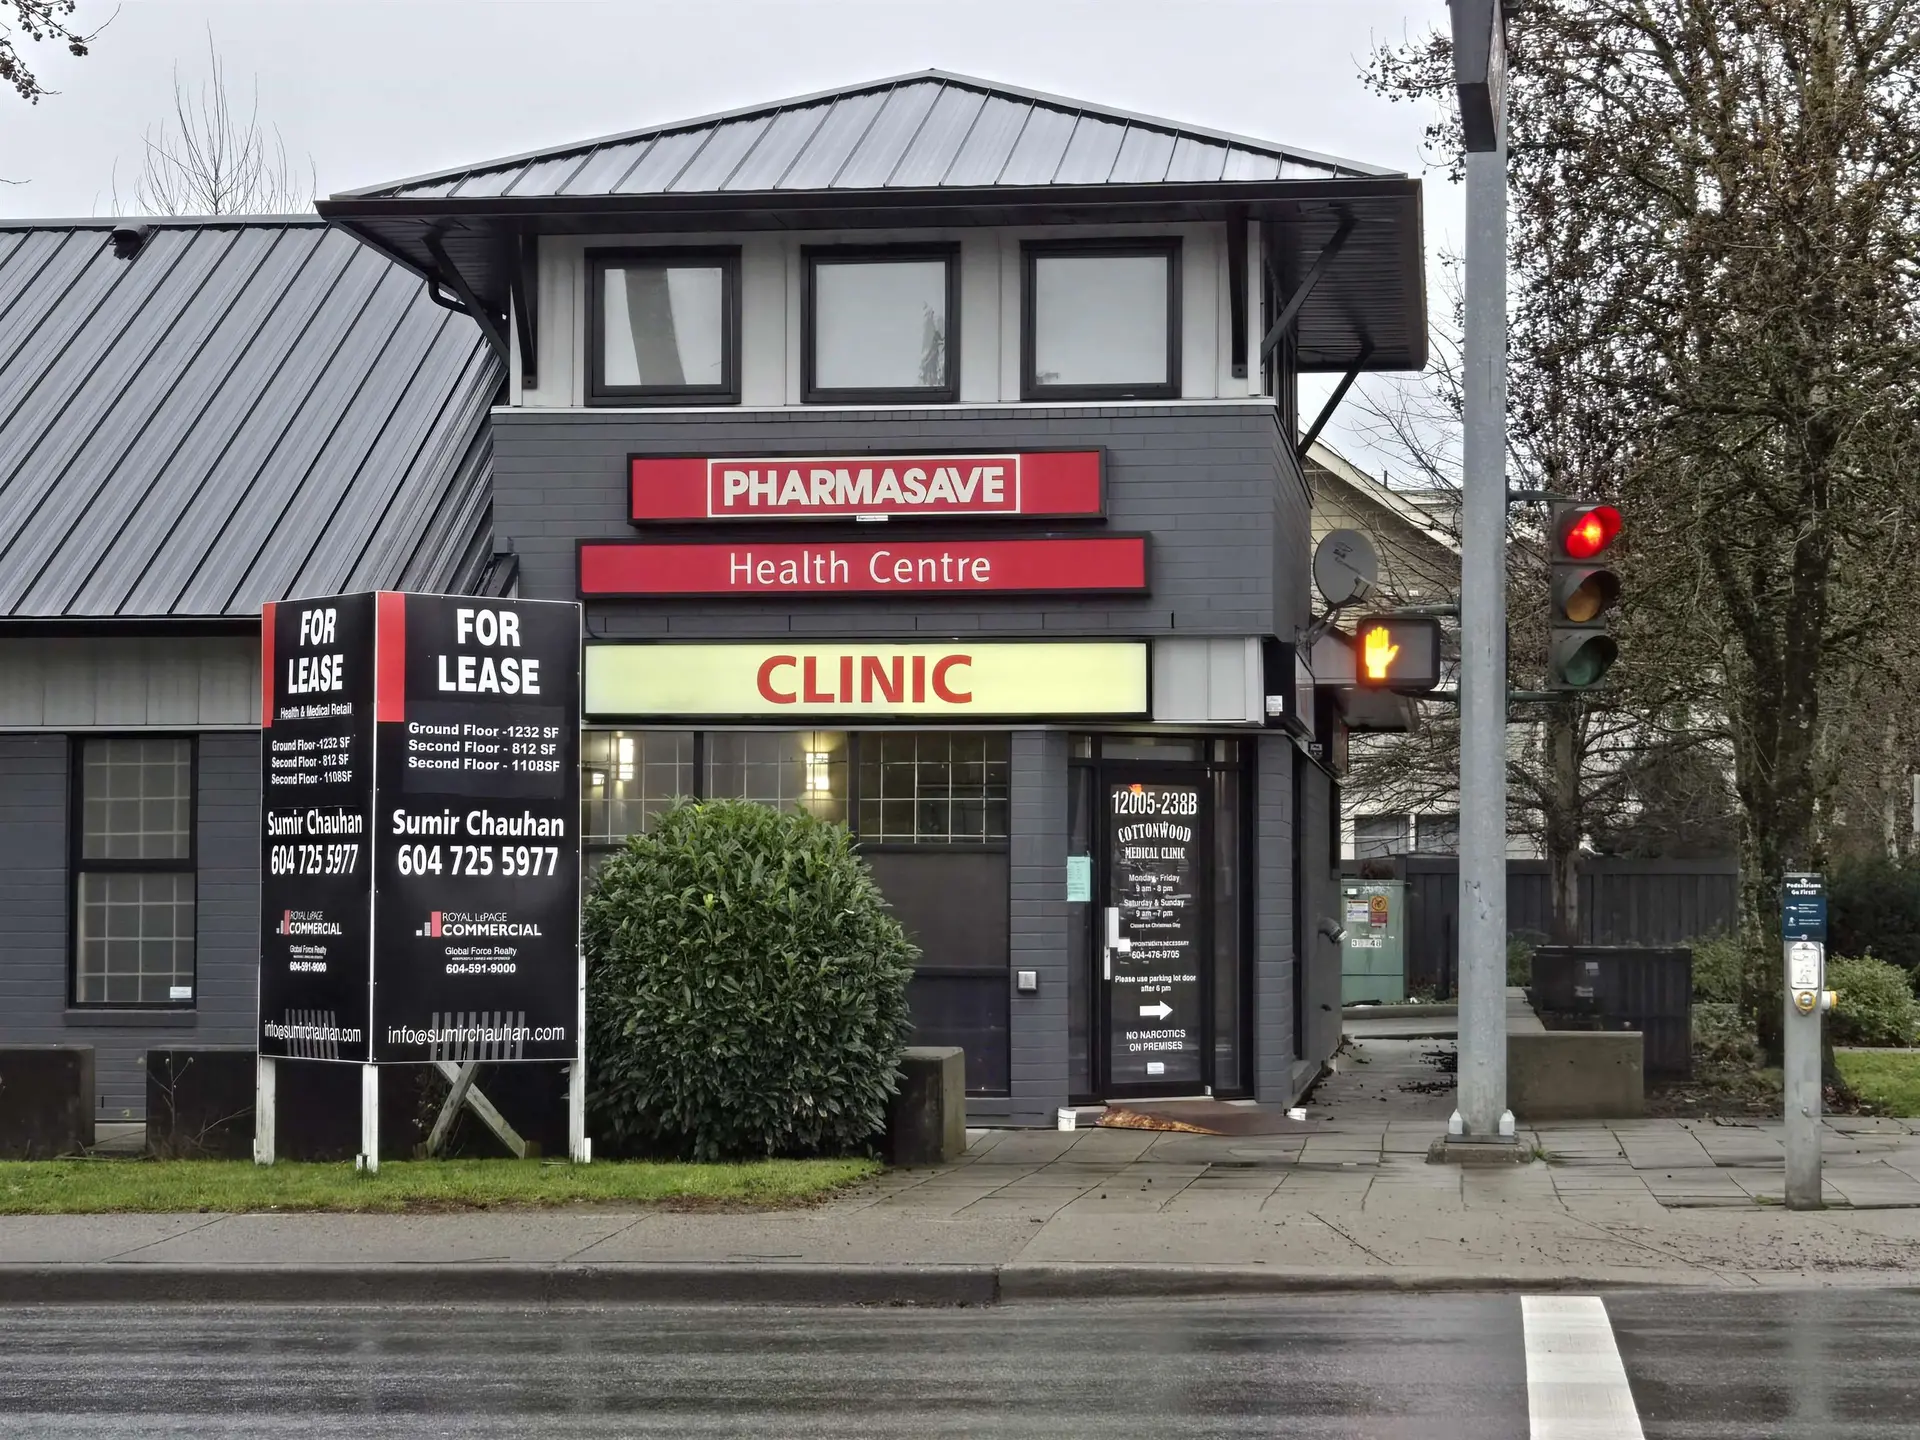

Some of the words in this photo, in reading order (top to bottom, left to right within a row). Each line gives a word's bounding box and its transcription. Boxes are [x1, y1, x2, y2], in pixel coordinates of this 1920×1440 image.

[723, 466, 1004, 507] PHARMASAVE
[730, 551, 849, 585] Health
[869, 551, 991, 584] Centre
[300, 608, 336, 646] FOR
[457, 608, 521, 647] FOR
[288, 654, 344, 694] LEASE
[438, 655, 540, 695] LEASE
[756, 654, 973, 704] CLINIC
[281, 707, 299, 718] Health
[301, 707, 305, 717] &
[307, 705, 330, 717] Medical
[331, 702, 352, 716] Retail
[408, 722, 459, 736] Ground
[464, 723, 499, 737] Floor
[543, 727, 559, 738] SF
[272, 739, 298, 751] Ground
[299, 739, 316, 750] Floor
[340, 737, 350, 748] SF
[408, 740, 459, 753] Second
[464, 741, 499, 754] Floor
[512, 743, 536, 755] 812
[541, 744, 556, 755] SF
[271, 757, 298, 768] Second
[298, 756, 316, 768] Floor
[323, 754, 338, 766] 812
[340, 754, 349, 765] SF
[408, 756, 459, 769] Second
[464, 758, 499, 771] Floor
[512, 759, 560, 772] 1108SF
[271, 773, 297, 784] Second
[298, 773, 317, 784] Floor
[324, 770, 352, 783] 1108SF
[1112, 790, 1197, 815] 12005-238B
[268, 809, 303, 836] Sumir
[307, 808, 362, 834] Chauhan
[393, 808, 459, 835] Sumir
[467, 810, 564, 837] Chauhan
[1118, 821, 1191, 843] COTTONWOOD
[271, 846, 294, 875] 604
[298, 845, 322, 874] 725
[325, 844, 358, 874] 5977
[398, 845, 442, 876] 604
[450, 846, 492, 875] 725
[502, 846, 559, 876] 5977
[1125, 847, 1158, 859] MEDICAL
[1161, 847, 1185, 859] CLINIC
[1129, 874, 1156, 882] Monday
[1160, 874, 1180, 882] Friday
[1124, 899, 1152, 908] Saturday
[1161, 899, 1184, 908] Sunday
[443, 913, 472, 921] ROYAL
[289, 922, 342, 934] COMMERCIAL
[442, 924, 542, 936] COMMERCIAL
[290, 945, 302, 953] Global
[445, 947, 469, 955] Global
[471, 947, 492, 955] Force
[494, 947, 517, 956] Realty
[290, 962, 326, 972] 604-591-9000
[446, 964, 516, 973] 604-591-9000
[1115, 975, 1135, 983] Please
[1149, 975, 1172, 983] parking
[264, 1020, 361, 1043] info@sumirchauhan.com
[388, 1026, 565, 1044] info@sumirchauhan.com
[1126, 1031, 1138, 1040] NO
[1140, 1030, 1186, 1038] NARCOTICS
[1130, 1043, 1141, 1051] ON
[1144, 1041, 1182, 1051] PREMISES
